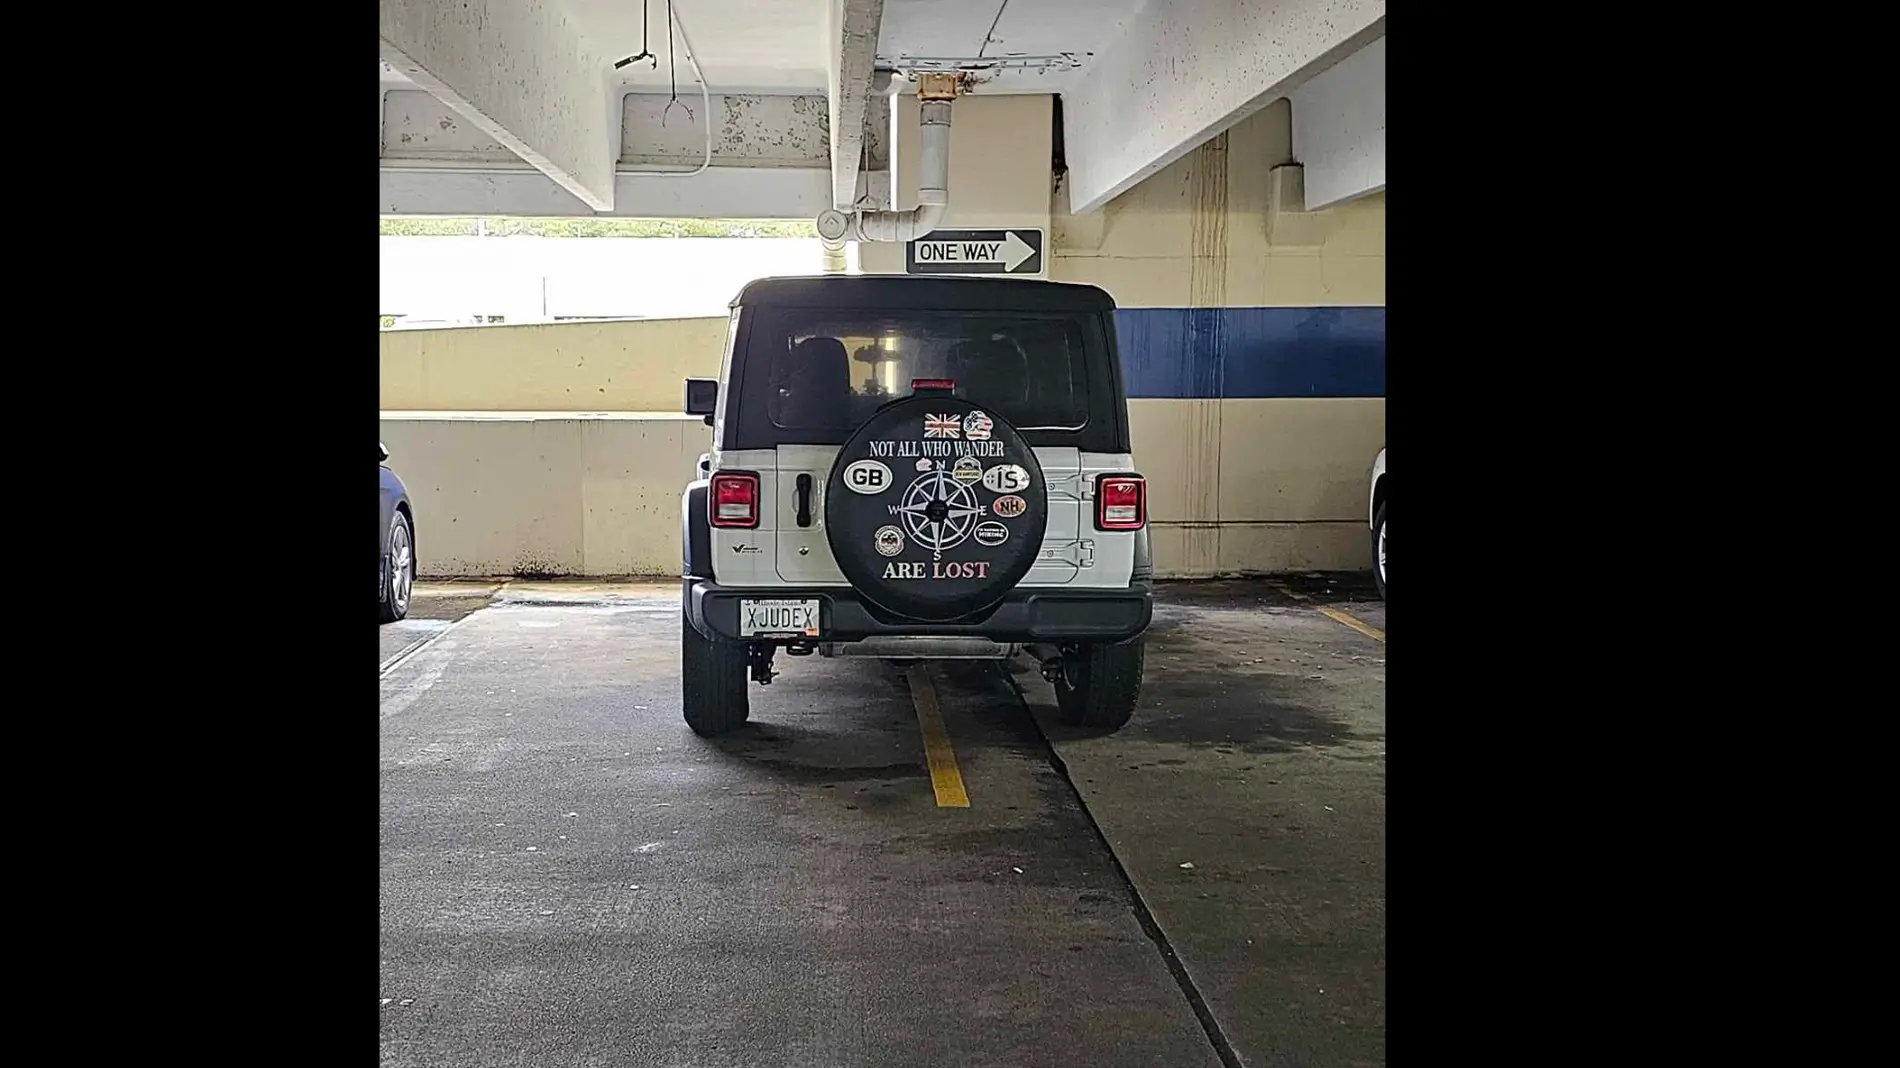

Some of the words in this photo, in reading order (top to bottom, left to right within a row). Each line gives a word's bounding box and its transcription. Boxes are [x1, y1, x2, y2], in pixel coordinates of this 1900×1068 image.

[920, 243, 957, 260] ONE
[963, 243, 1000, 260] WAY
[869, 441, 895, 457] NOT
[897, 441, 919, 457] ALL
[922, 441, 951, 457] WHO
[954, 441, 1004, 457] WANDER
[935, 460, 946, 470] N
[852, 468, 883, 486] GB
[887, 505, 900, 515] W
[980, 505, 987, 516] E
[1000, 501, 1019, 512] NH
[933, 551, 941, 561] S
[882, 563, 926, 579] ARE
[932, 562, 990, 579] LOST
[748, 608, 812, 628] XJUDEX
